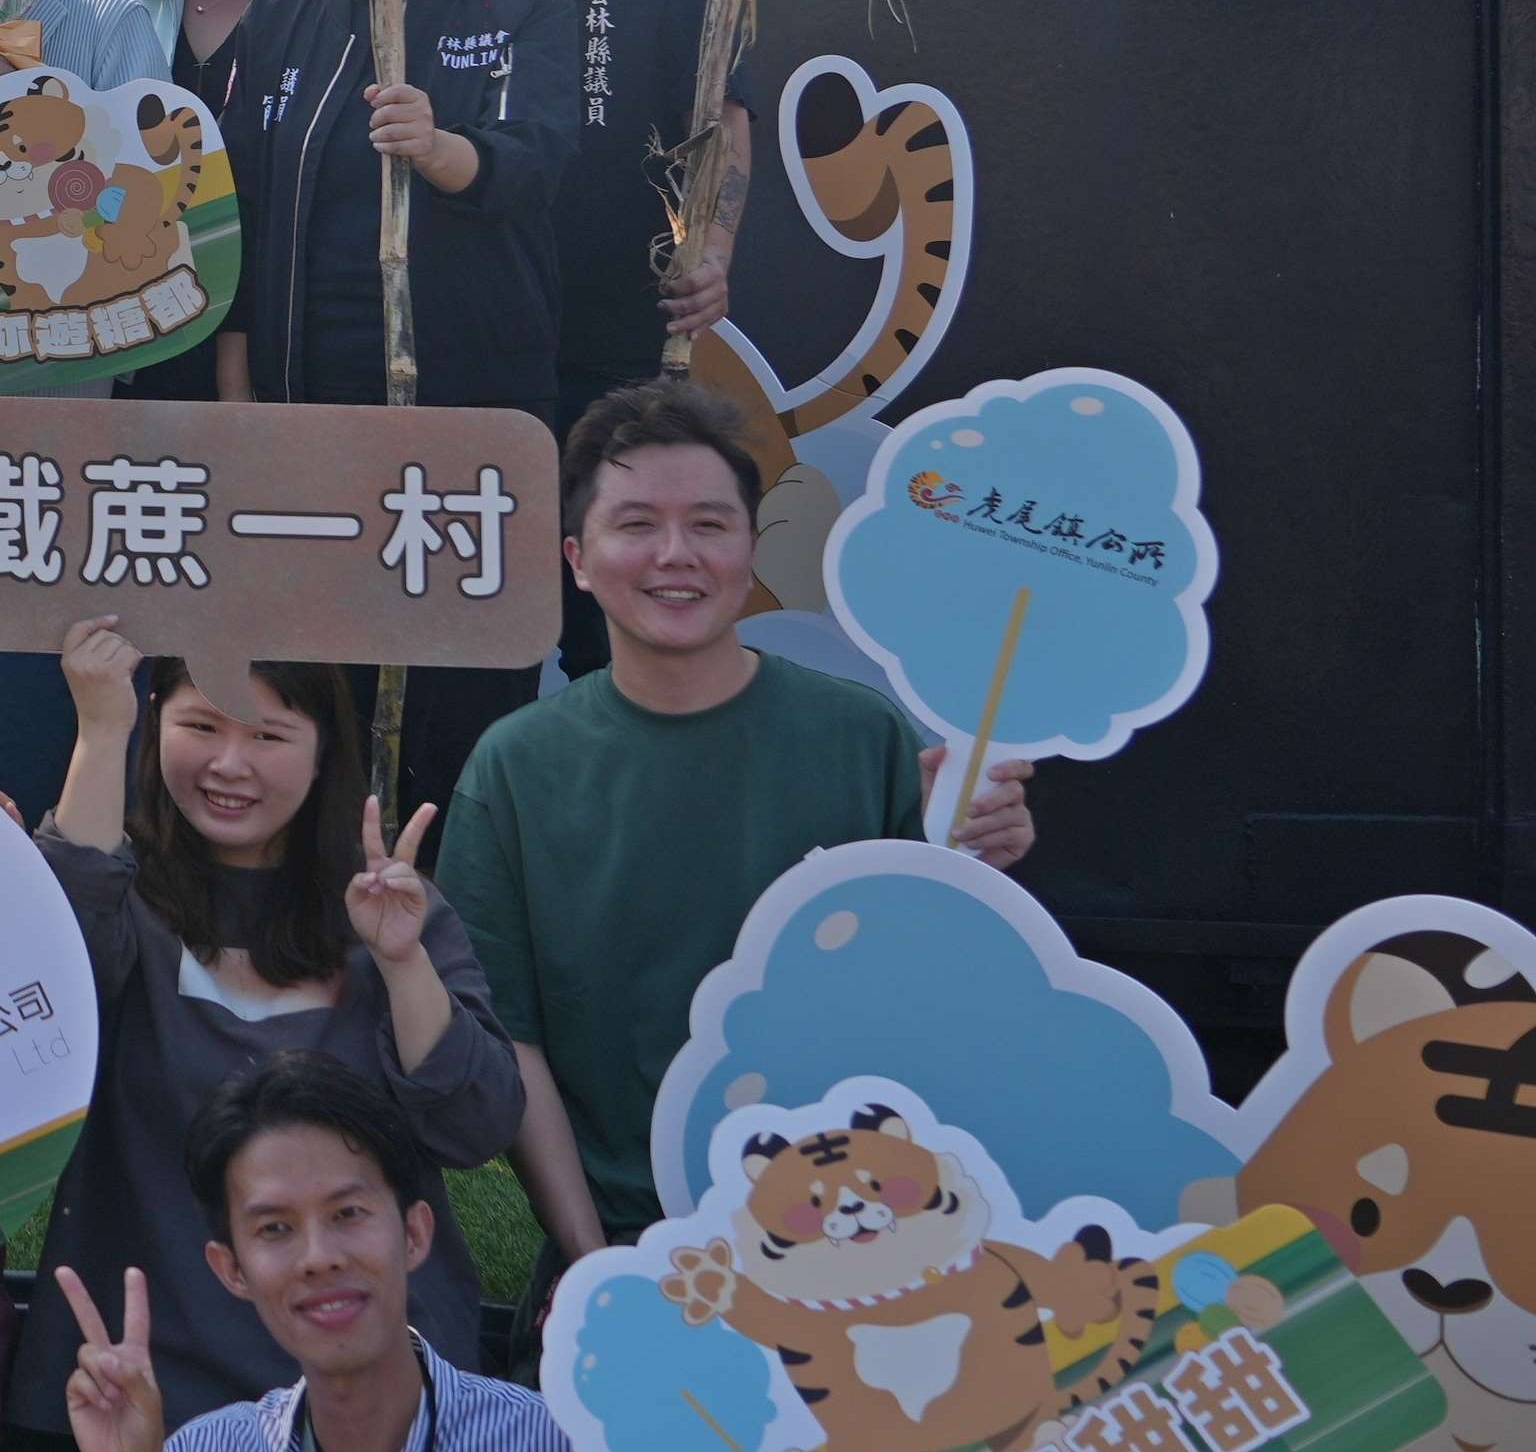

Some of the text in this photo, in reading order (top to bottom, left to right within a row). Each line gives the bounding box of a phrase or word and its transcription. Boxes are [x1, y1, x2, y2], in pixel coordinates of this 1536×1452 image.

[441, 49, 498, 69] YUNLIN
[963, 519, 997, 537] Huwei
[999, 529, 1054, 554] Township
[1086, 555, 1118, 574] Yunlin
[1118, 566, 1159, 588] County
[966, 486, 1166, 570] 虎尾鎮公所
[12, 1027, 73, 1077] Ltd
